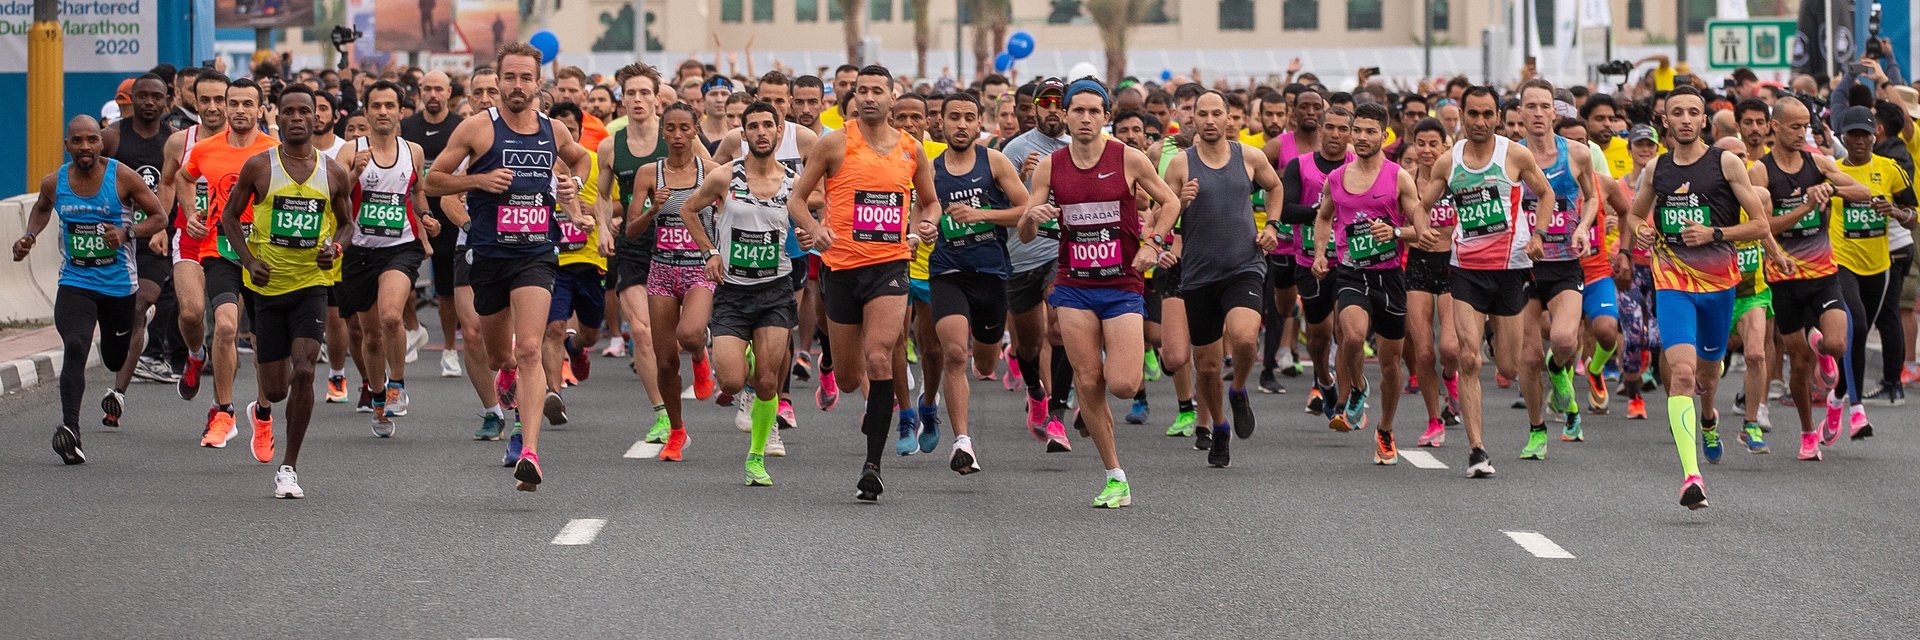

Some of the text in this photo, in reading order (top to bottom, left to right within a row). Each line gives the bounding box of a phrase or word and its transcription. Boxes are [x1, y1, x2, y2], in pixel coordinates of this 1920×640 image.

[95, 40, 139, 54] 2020
[363, 205, 403, 220] 12665
[501, 208, 547, 225] 21500
[857, 206, 900, 224] 10005
[1071, 210, 1120, 221] SARADAR
[1430, 208, 1454, 221] 030
[1460, 201, 1502, 222] 22474
[1664, 208, 1704, 225] 19818
[277, 212, 319, 230] 13421
[73, 235, 110, 250] 1248
[661, 229, 692, 243] 2150
[1352, 234, 1391, 252] 127
[734, 243, 775, 261] 21473
[1072, 242, 1117, 260] 10007
